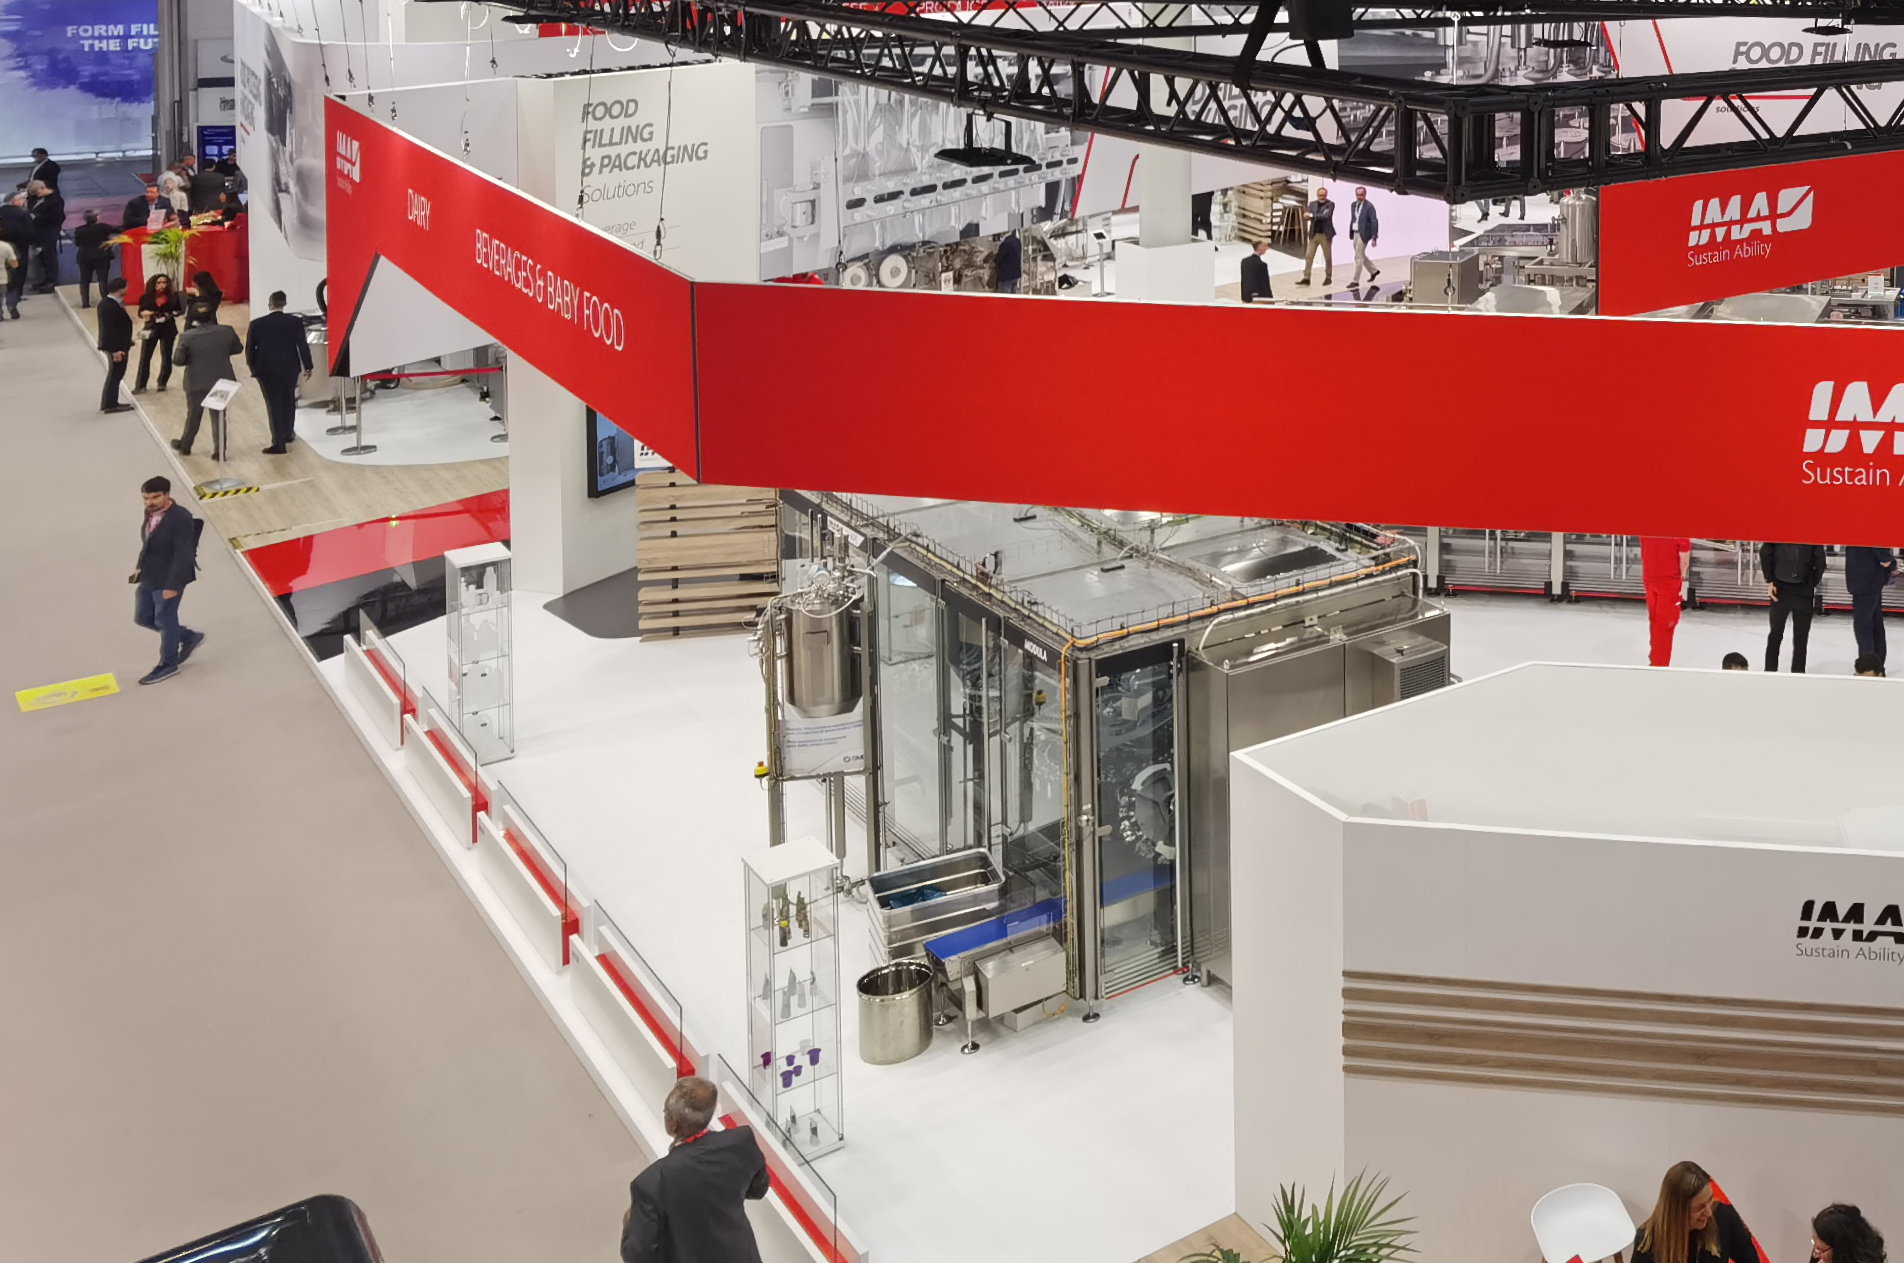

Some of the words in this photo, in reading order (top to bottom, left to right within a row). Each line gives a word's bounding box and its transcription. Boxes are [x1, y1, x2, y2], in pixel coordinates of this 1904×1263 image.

[66, 24, 124, 37] FORM
[80, 39, 121, 51] THE
[1732, 41, 1804, 65] FOOD
[581, 98, 639, 124] FOOD
[581, 122, 655, 150] FILLING
[582, 157, 596, 177] &
[598, 141, 709, 175] PACKAGING
[582, 180, 655, 205] Solutions
[408, 188, 431, 231] DAIRY
[1688, 191, 1773, 247] IMA
[1688, 246, 1730, 268] Sustain
[1733, 240, 1772, 259] Ability
[475, 228, 534, 298] BEVERAGES
[535, 264, 545, 304] &
[547, 270, 580, 325] BABY
[583, 291, 625, 351] FOOD
[1801, 460, 1891, 487] Sustain
[1024, 638, 1048, 662] MODULA
[1795, 942, 1850, 959] Sustain
